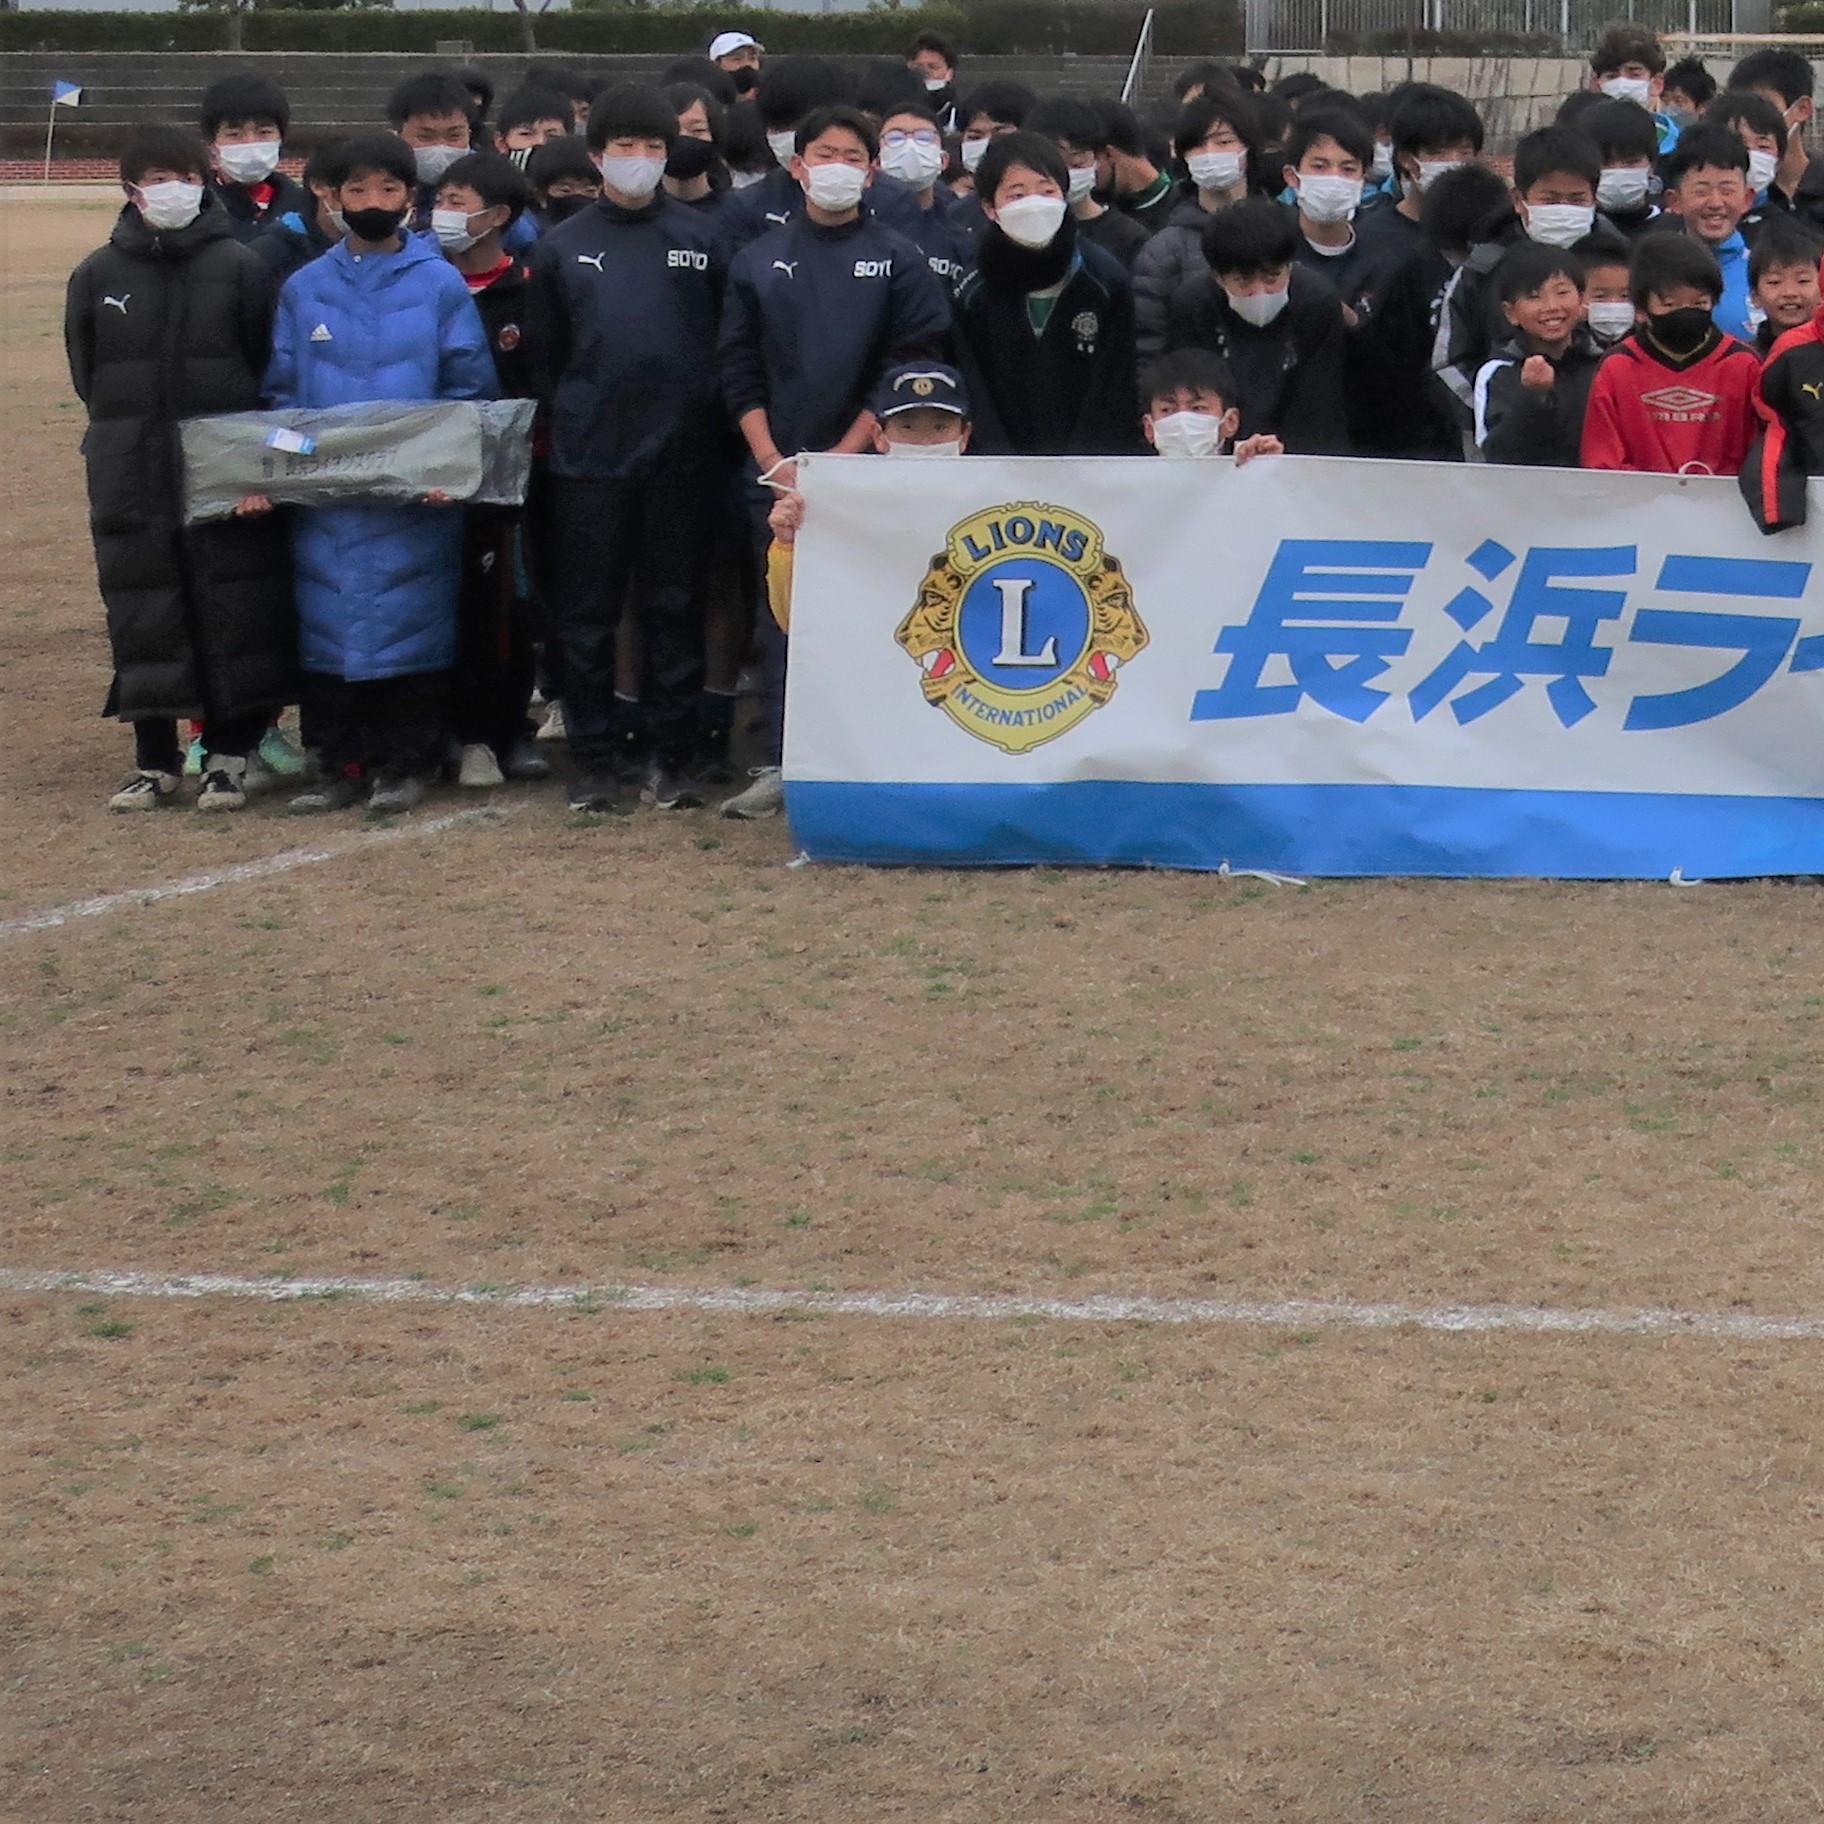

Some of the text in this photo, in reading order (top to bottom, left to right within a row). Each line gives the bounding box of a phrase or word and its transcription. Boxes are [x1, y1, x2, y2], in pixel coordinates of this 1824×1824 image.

[962, 516, 1089, 562] LIONS
[992, 578, 1058, 666] L
[951, 682, 1089, 727] INTERNATIONAL
